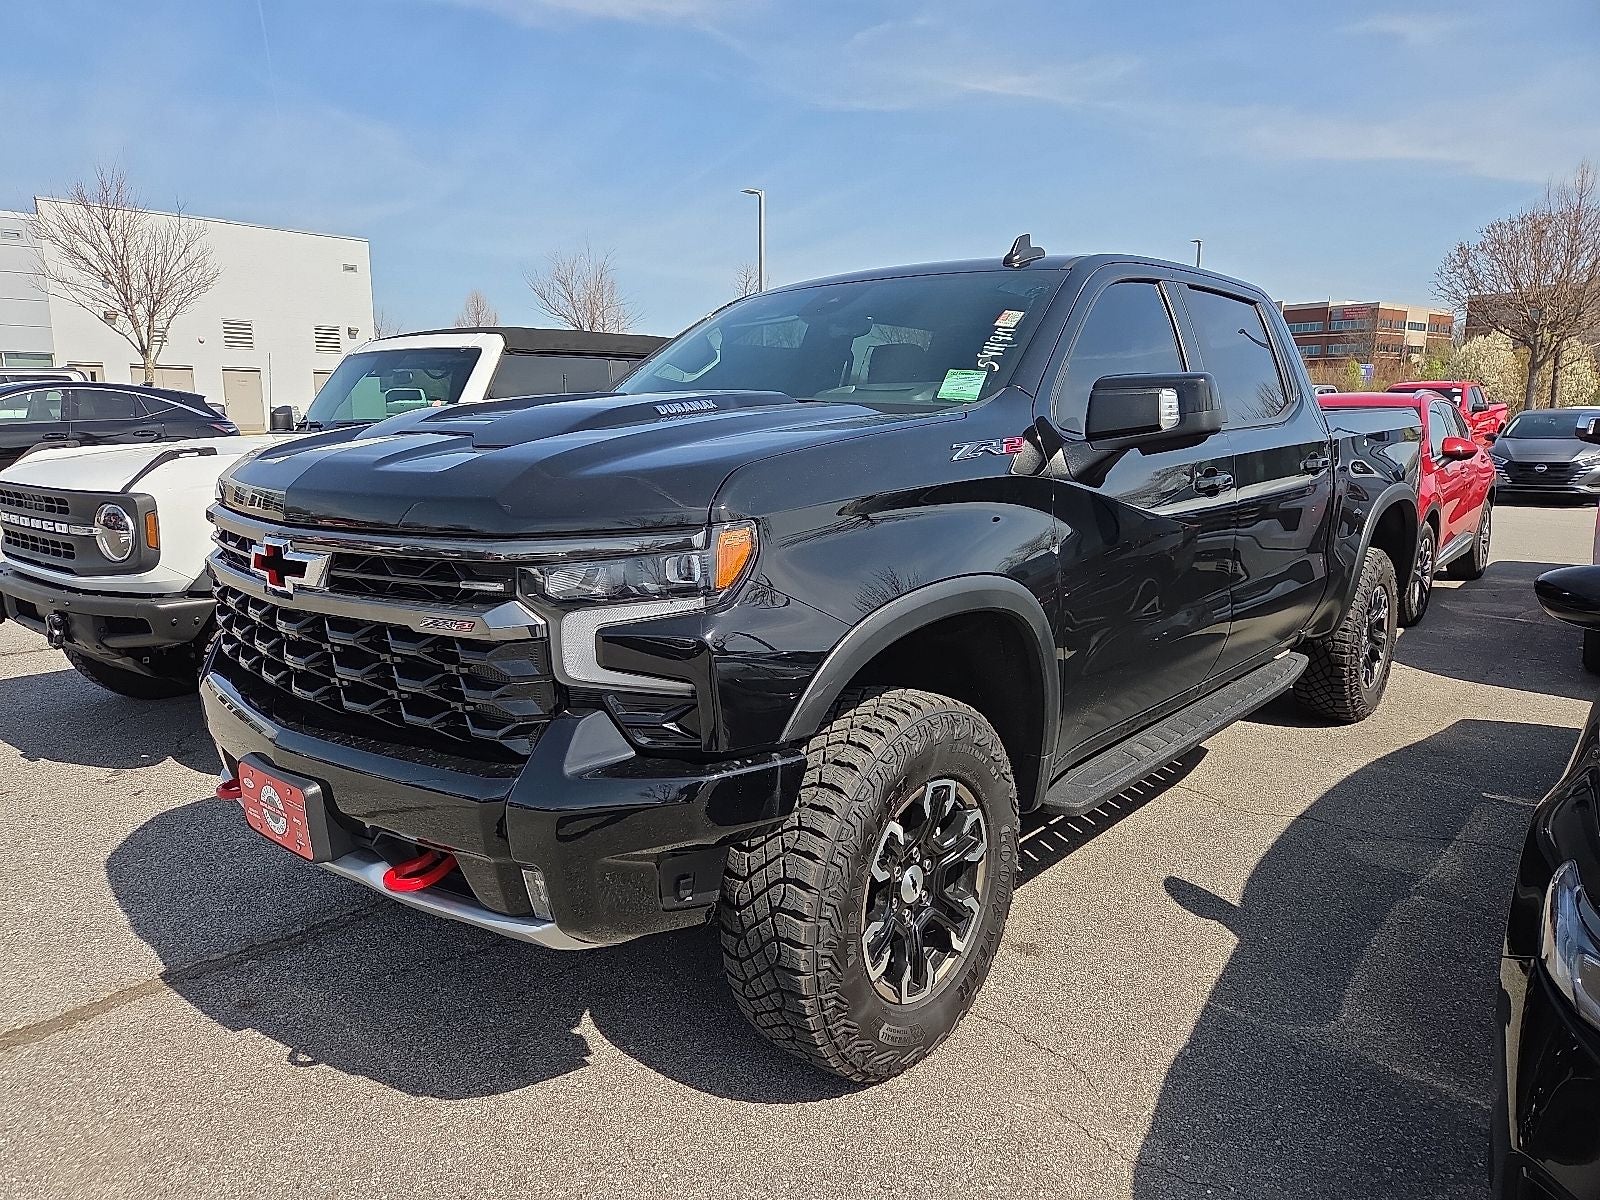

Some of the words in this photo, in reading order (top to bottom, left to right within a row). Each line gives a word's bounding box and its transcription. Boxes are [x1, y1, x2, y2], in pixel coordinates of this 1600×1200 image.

[653, 399, 718, 415] DURAMAX
[951, 437, 1023, 462] ZR2
[1, 511, 68, 534] BRONCO
